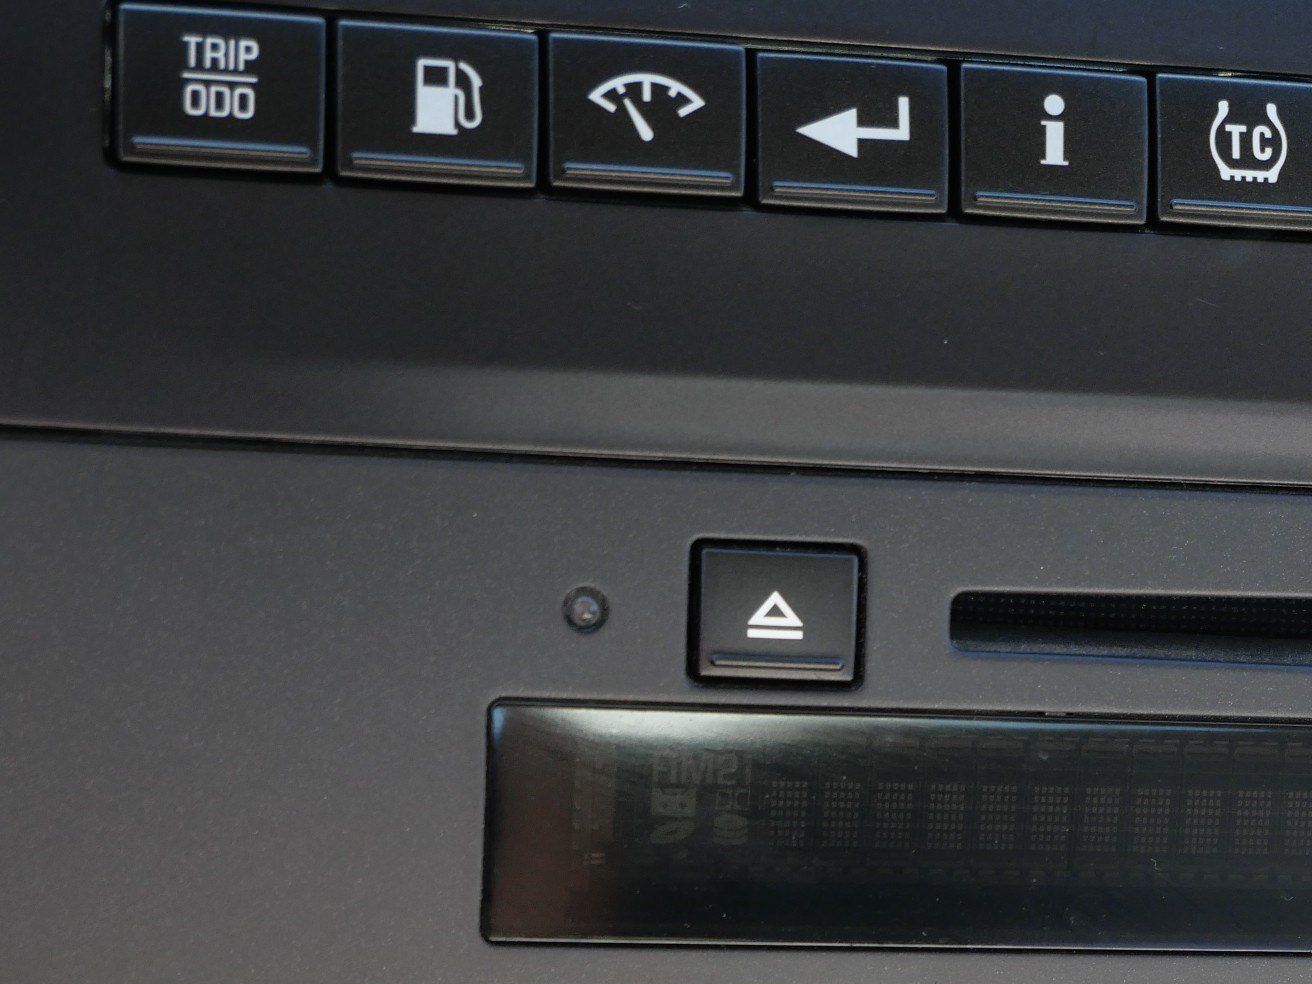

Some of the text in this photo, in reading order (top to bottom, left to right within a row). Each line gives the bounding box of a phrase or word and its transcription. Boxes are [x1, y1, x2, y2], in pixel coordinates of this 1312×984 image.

[182, 35, 260, 71] TRIP
[183, 83, 257, 120] ODO
[1225, 123, 1273, 162] TC
